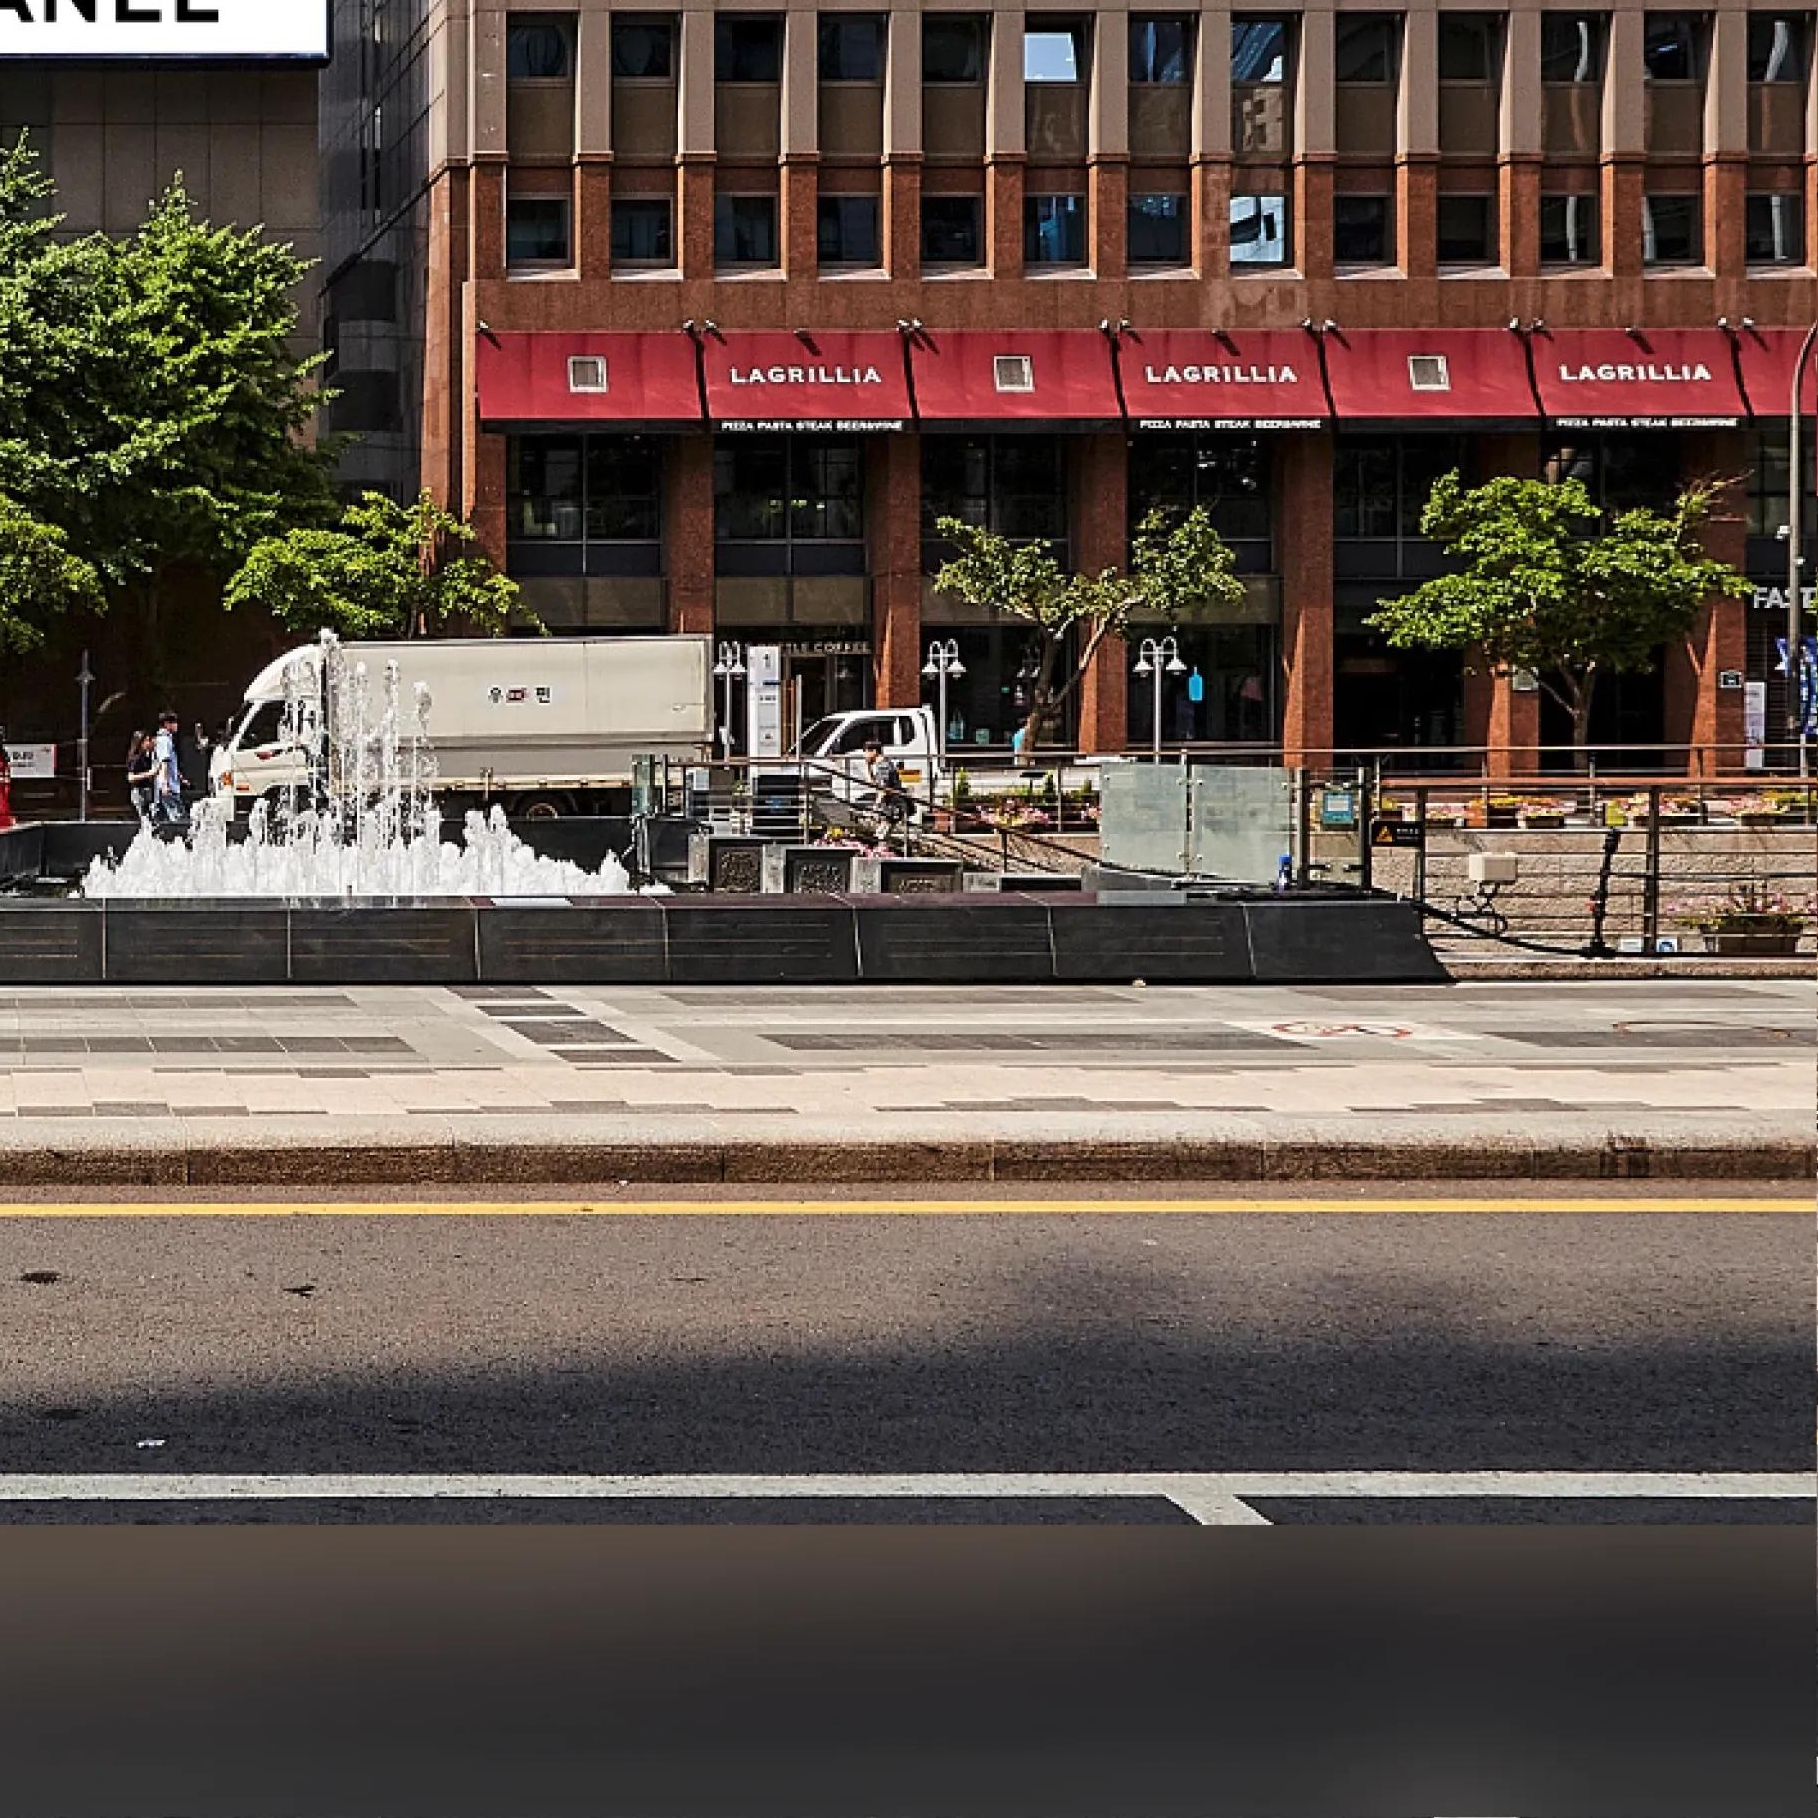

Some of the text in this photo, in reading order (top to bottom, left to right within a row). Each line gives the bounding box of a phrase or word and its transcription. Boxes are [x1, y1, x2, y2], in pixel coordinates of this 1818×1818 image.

[731, 367, 882, 384] LAGRILLIA
[1146, 365, 1299, 384] LAGRILLIA
[1559, 363, 1712, 381] LAGRILLIA
[721, 421, 754, 431] PIZZA
[757, 421, 793, 431] PASTA
[795, 421, 832, 431] STEAK
[1139, 420, 1172, 429] PIZZA
[1175, 420, 1211, 429] PASTA
[1214, 420, 1252, 429] STEAK
[1556, 418, 1590, 427] PIZZA
[1592, 418, 1629, 427] PASTA
[1631, 418, 1668, 427] STEAK
